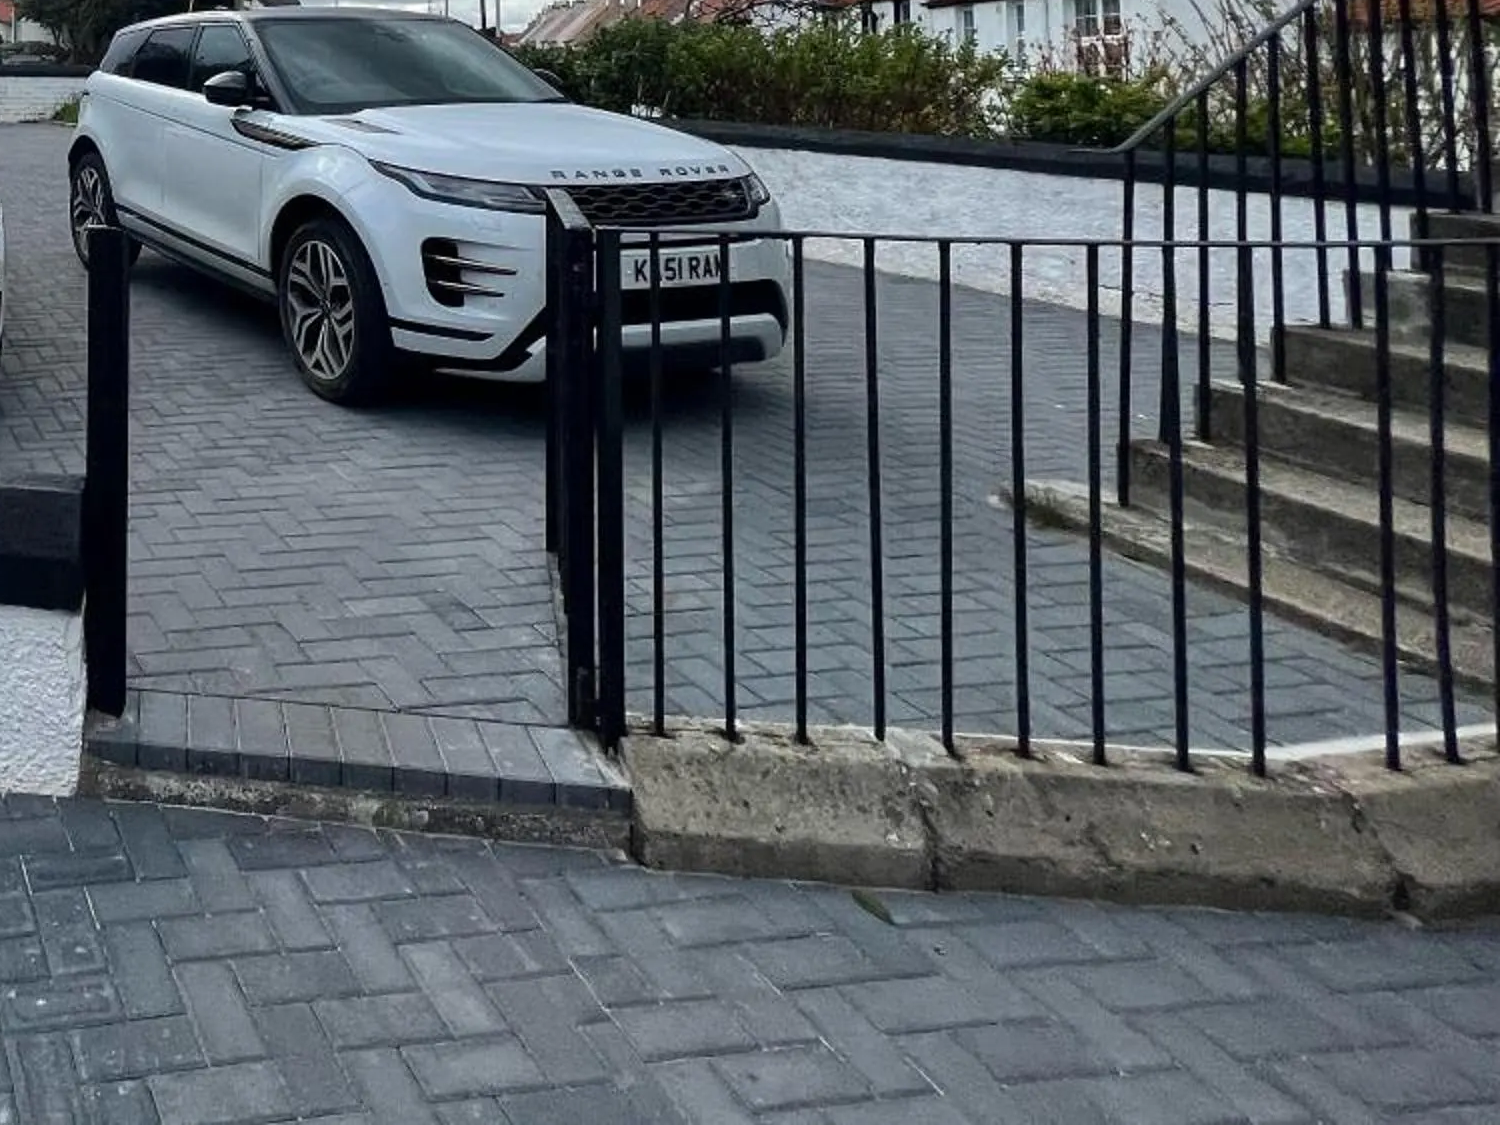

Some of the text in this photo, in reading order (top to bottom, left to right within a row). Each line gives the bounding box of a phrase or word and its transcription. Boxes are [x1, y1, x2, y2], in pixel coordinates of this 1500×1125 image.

[550, 164, 730, 180] RANGE ROVER
[634, 257, 683, 282] K51
